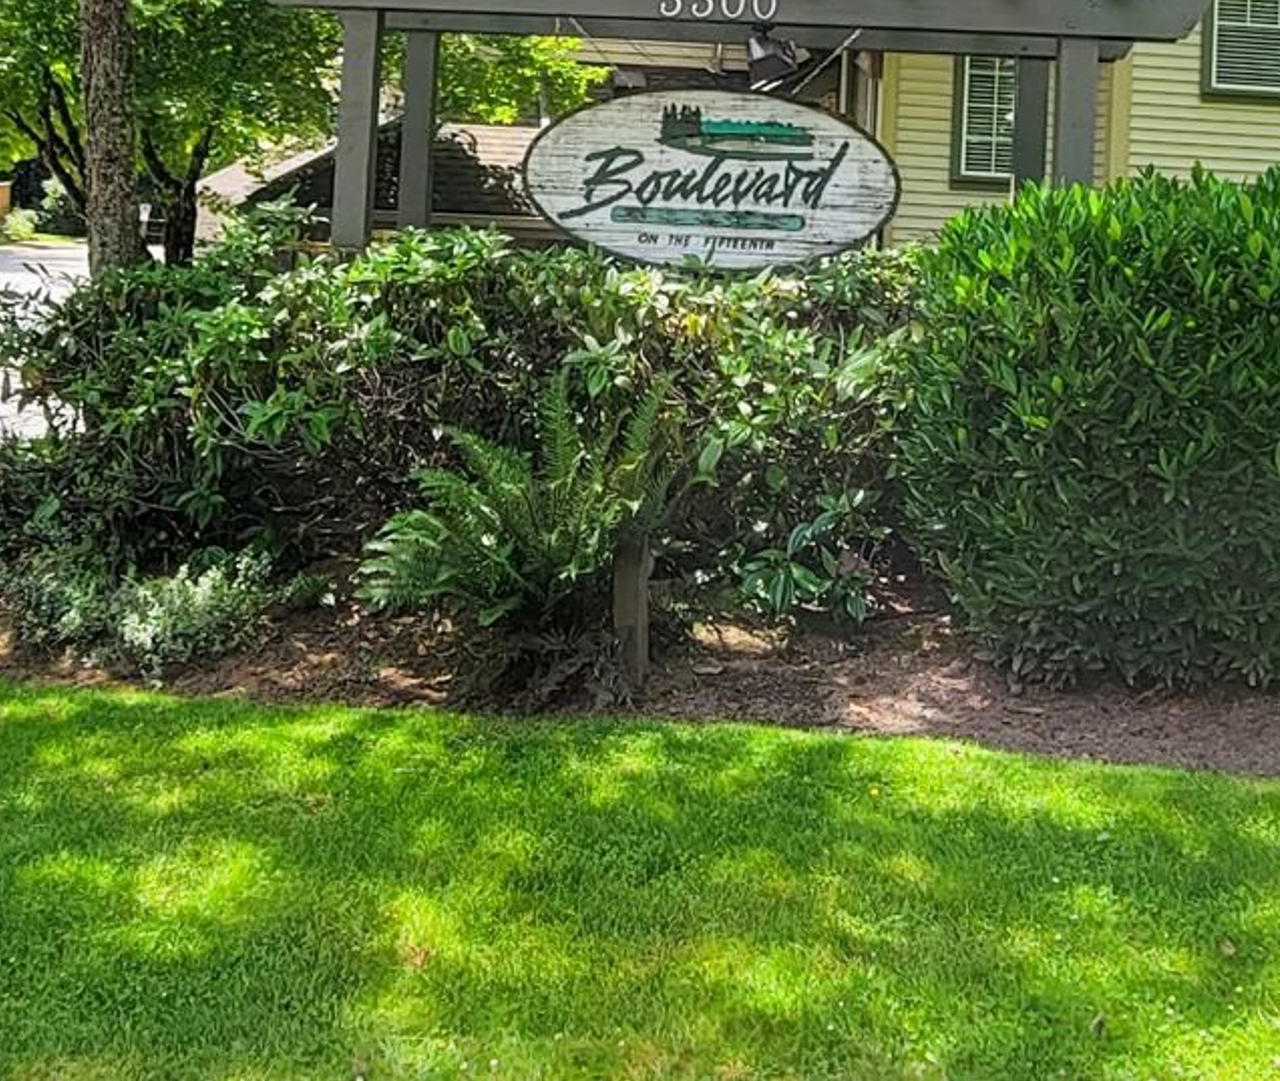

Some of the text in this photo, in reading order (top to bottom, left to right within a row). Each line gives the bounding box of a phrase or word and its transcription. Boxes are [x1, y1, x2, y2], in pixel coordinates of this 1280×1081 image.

[558, 141, 849, 220] Boulevard
[637, 232, 659, 245] ON
[668, 234, 691, 248] THE
